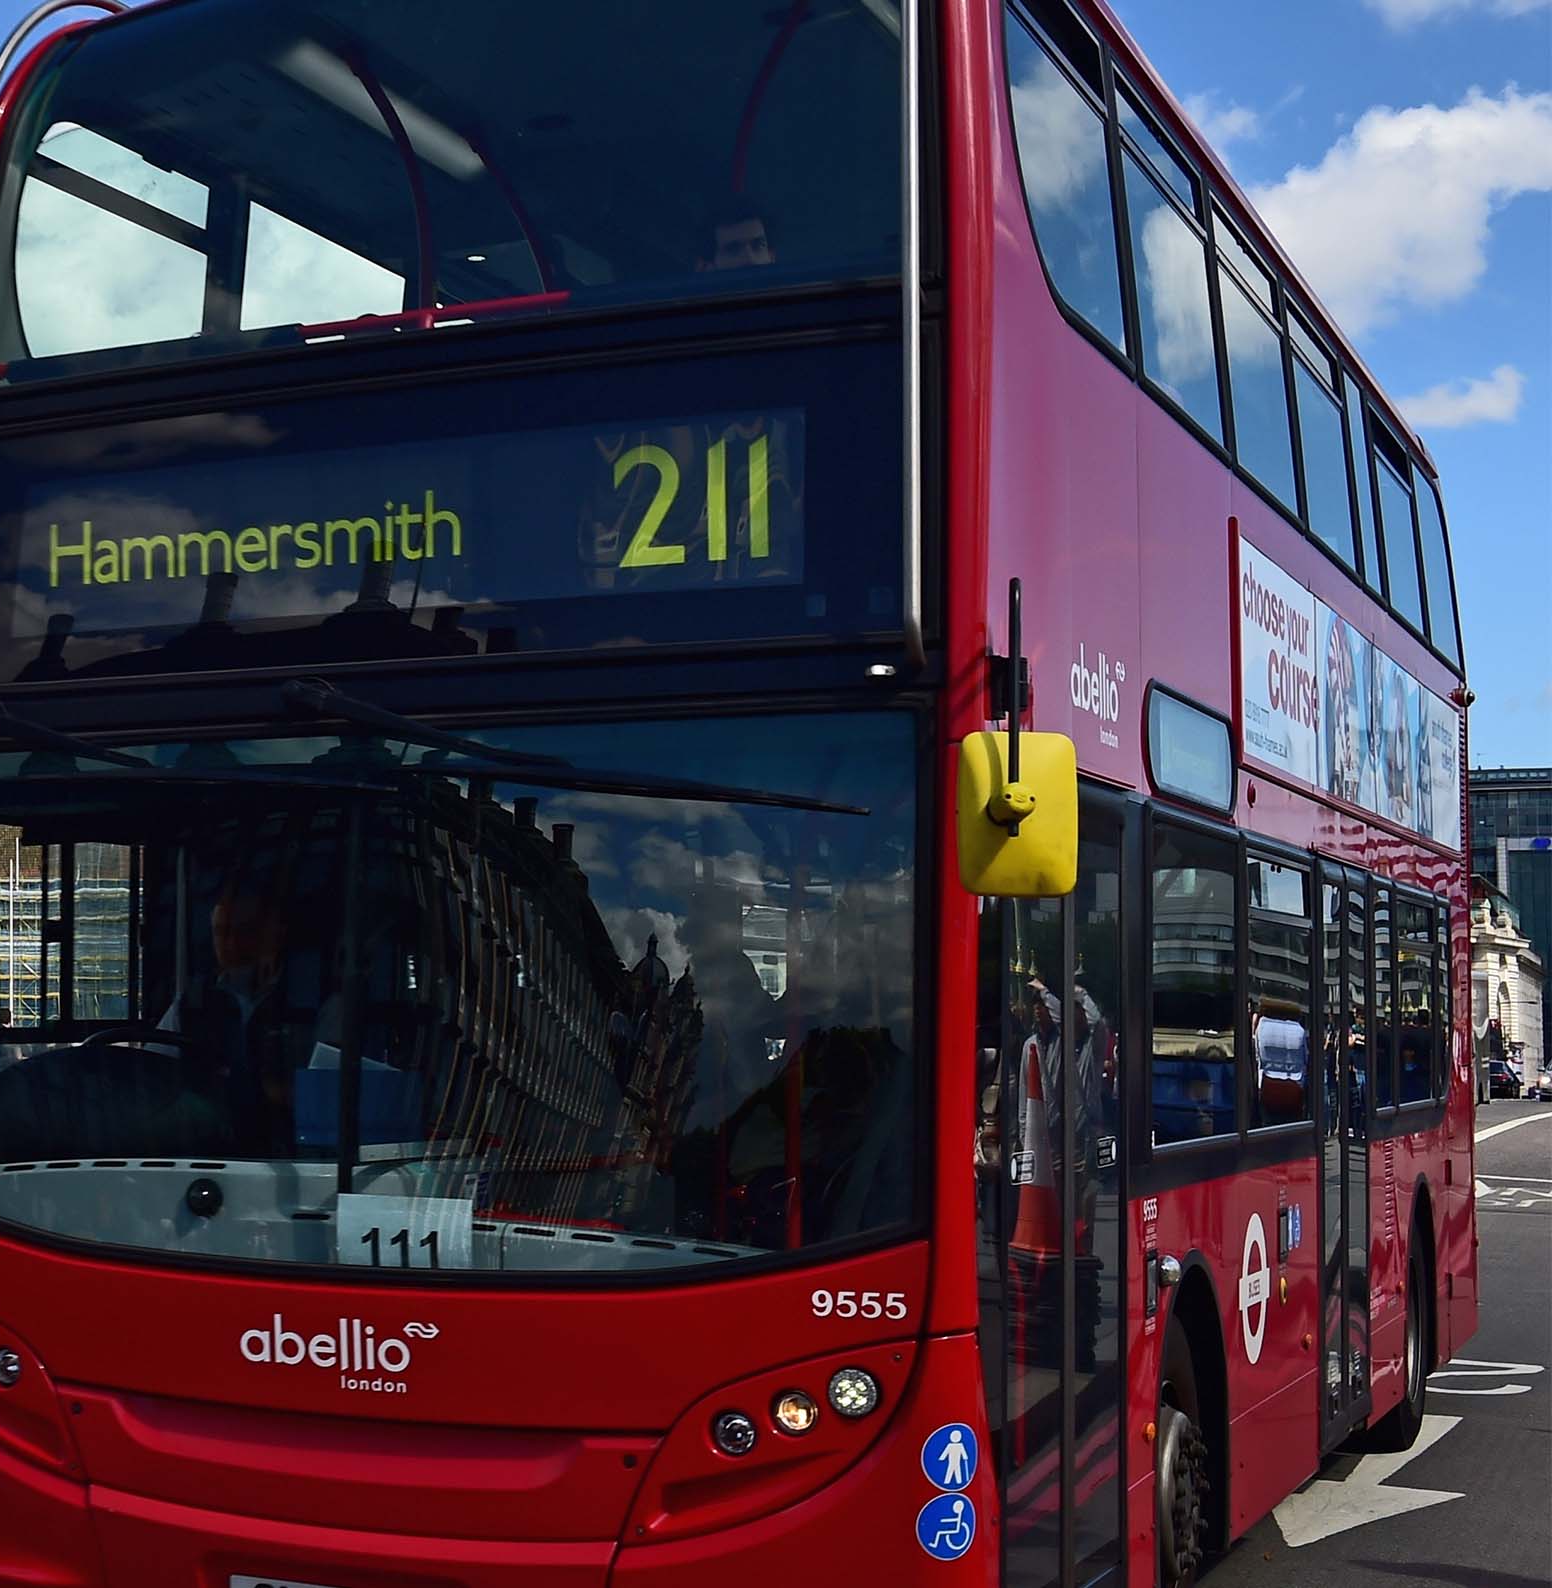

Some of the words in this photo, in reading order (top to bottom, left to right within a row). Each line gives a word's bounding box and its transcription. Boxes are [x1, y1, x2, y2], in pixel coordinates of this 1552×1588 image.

[614, 434, 770, 568] 211
[50, 490, 462, 588] Hammersmith
[1242, 561, 1286, 641] choose
[1286, 604, 1310, 657] your
[1070, 642, 1119, 723] abellio
[1100, 725, 1119, 749] london
[1143, 1198, 1158, 1222] 9555
[361, 1227, 439, 1269] 111
[811, 1289, 908, 1320] 9555
[240, 1313, 411, 1373] abellio
[340, 1375, 408, 1393] london
